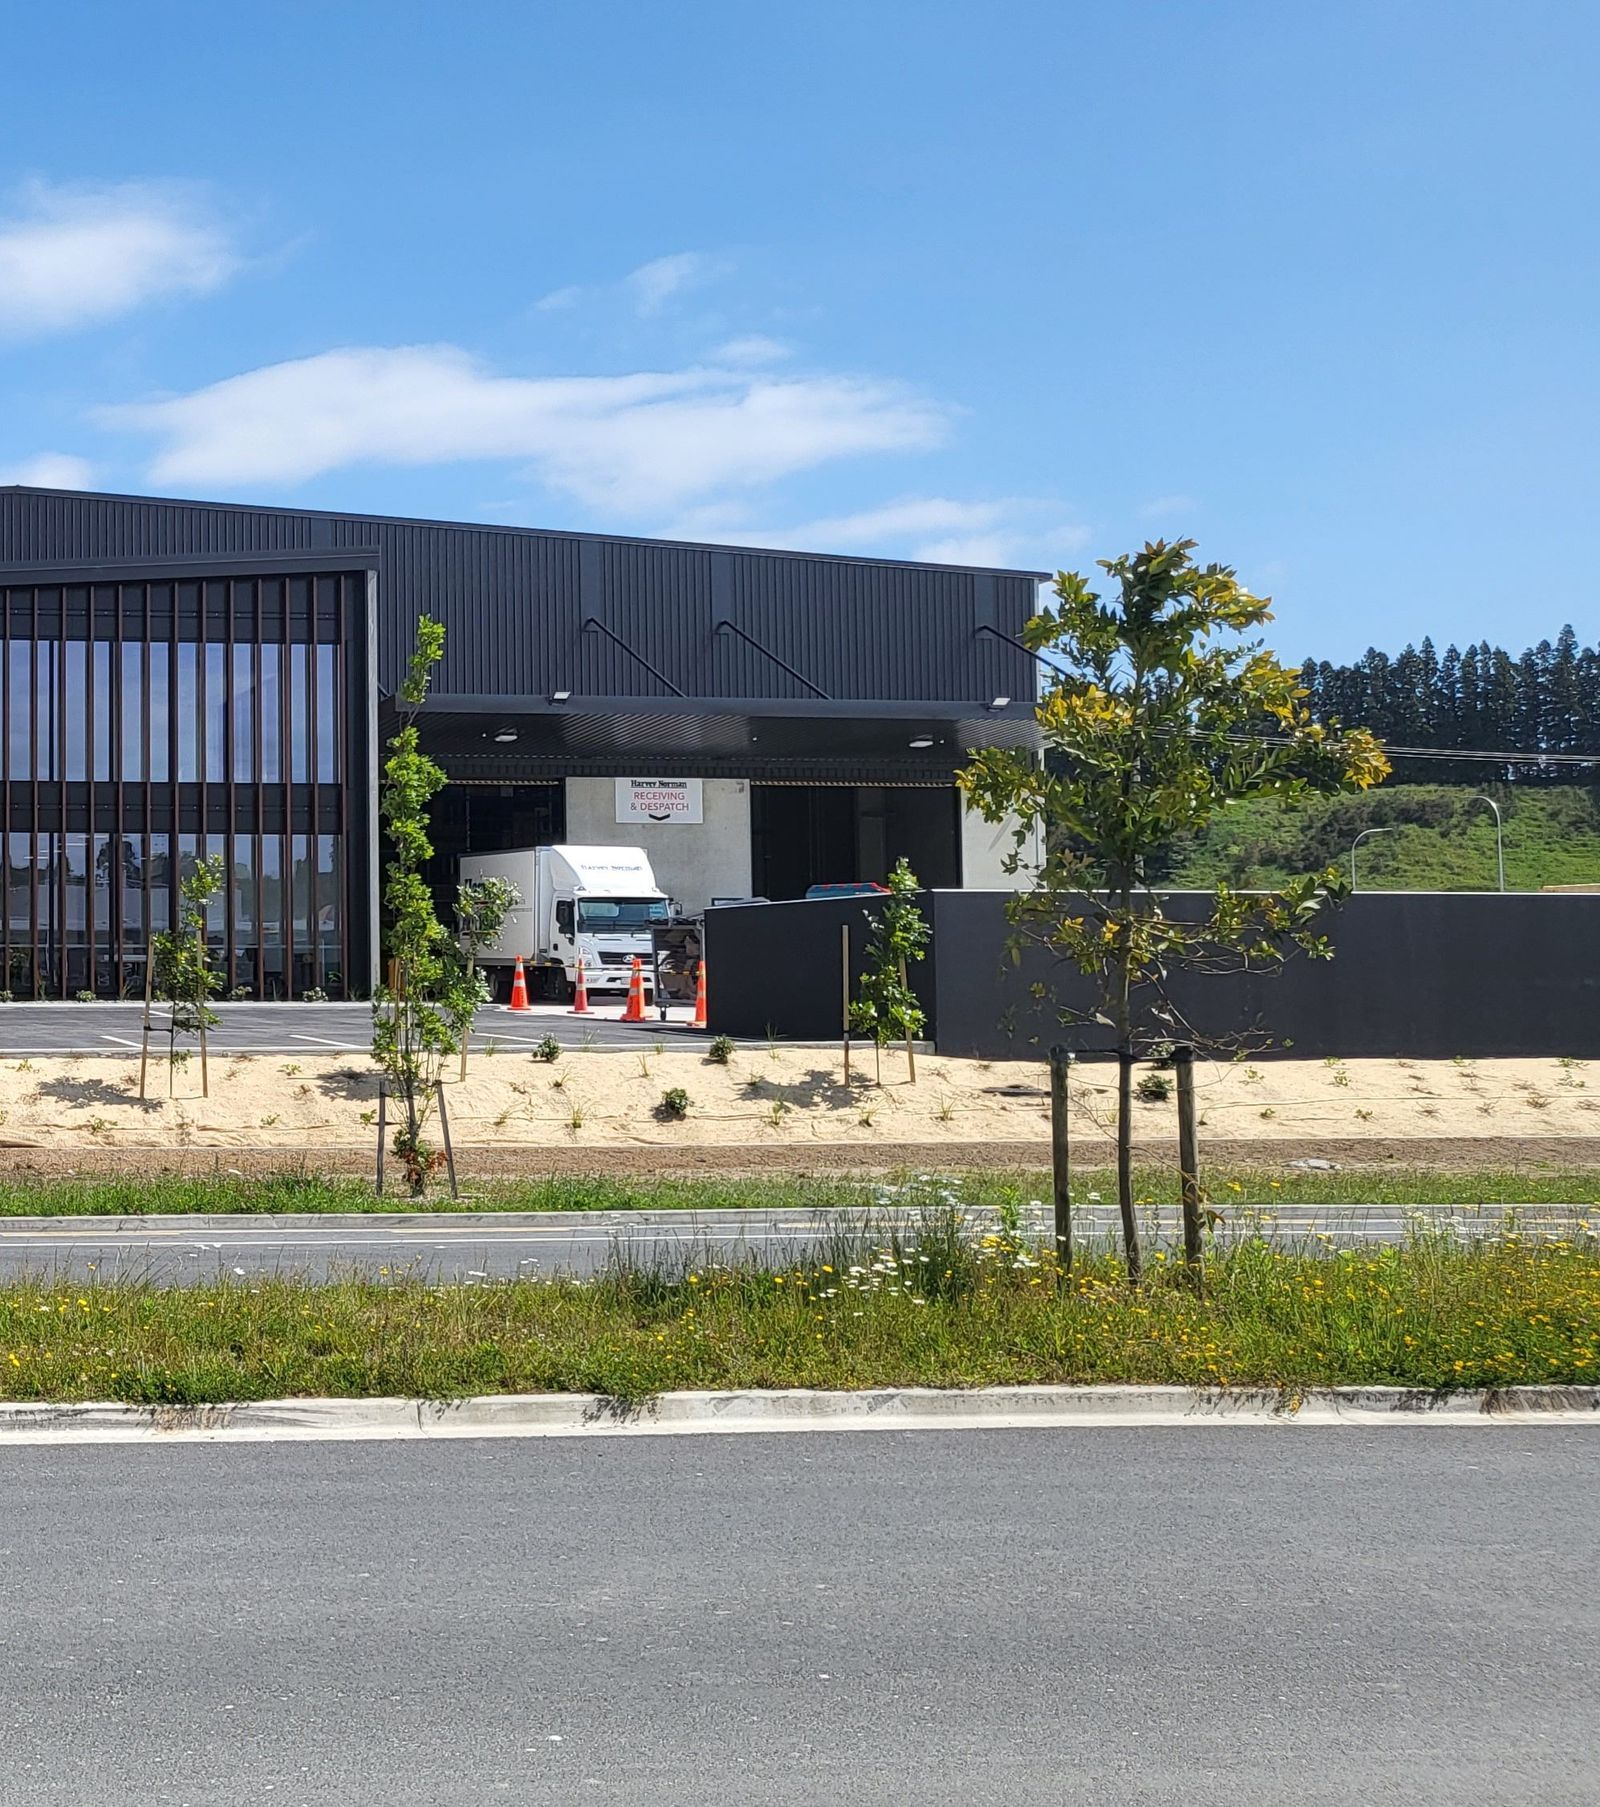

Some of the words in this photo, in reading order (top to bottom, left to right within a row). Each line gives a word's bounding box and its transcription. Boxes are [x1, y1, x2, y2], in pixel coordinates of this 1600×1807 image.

[631, 780, 658, 788] Harvey
[658, 780, 687, 788] Norman
[634, 792, 686, 801] RECEIVING
[630, 802, 638, 811] &
[640, 802, 690, 811] DESPATCH
